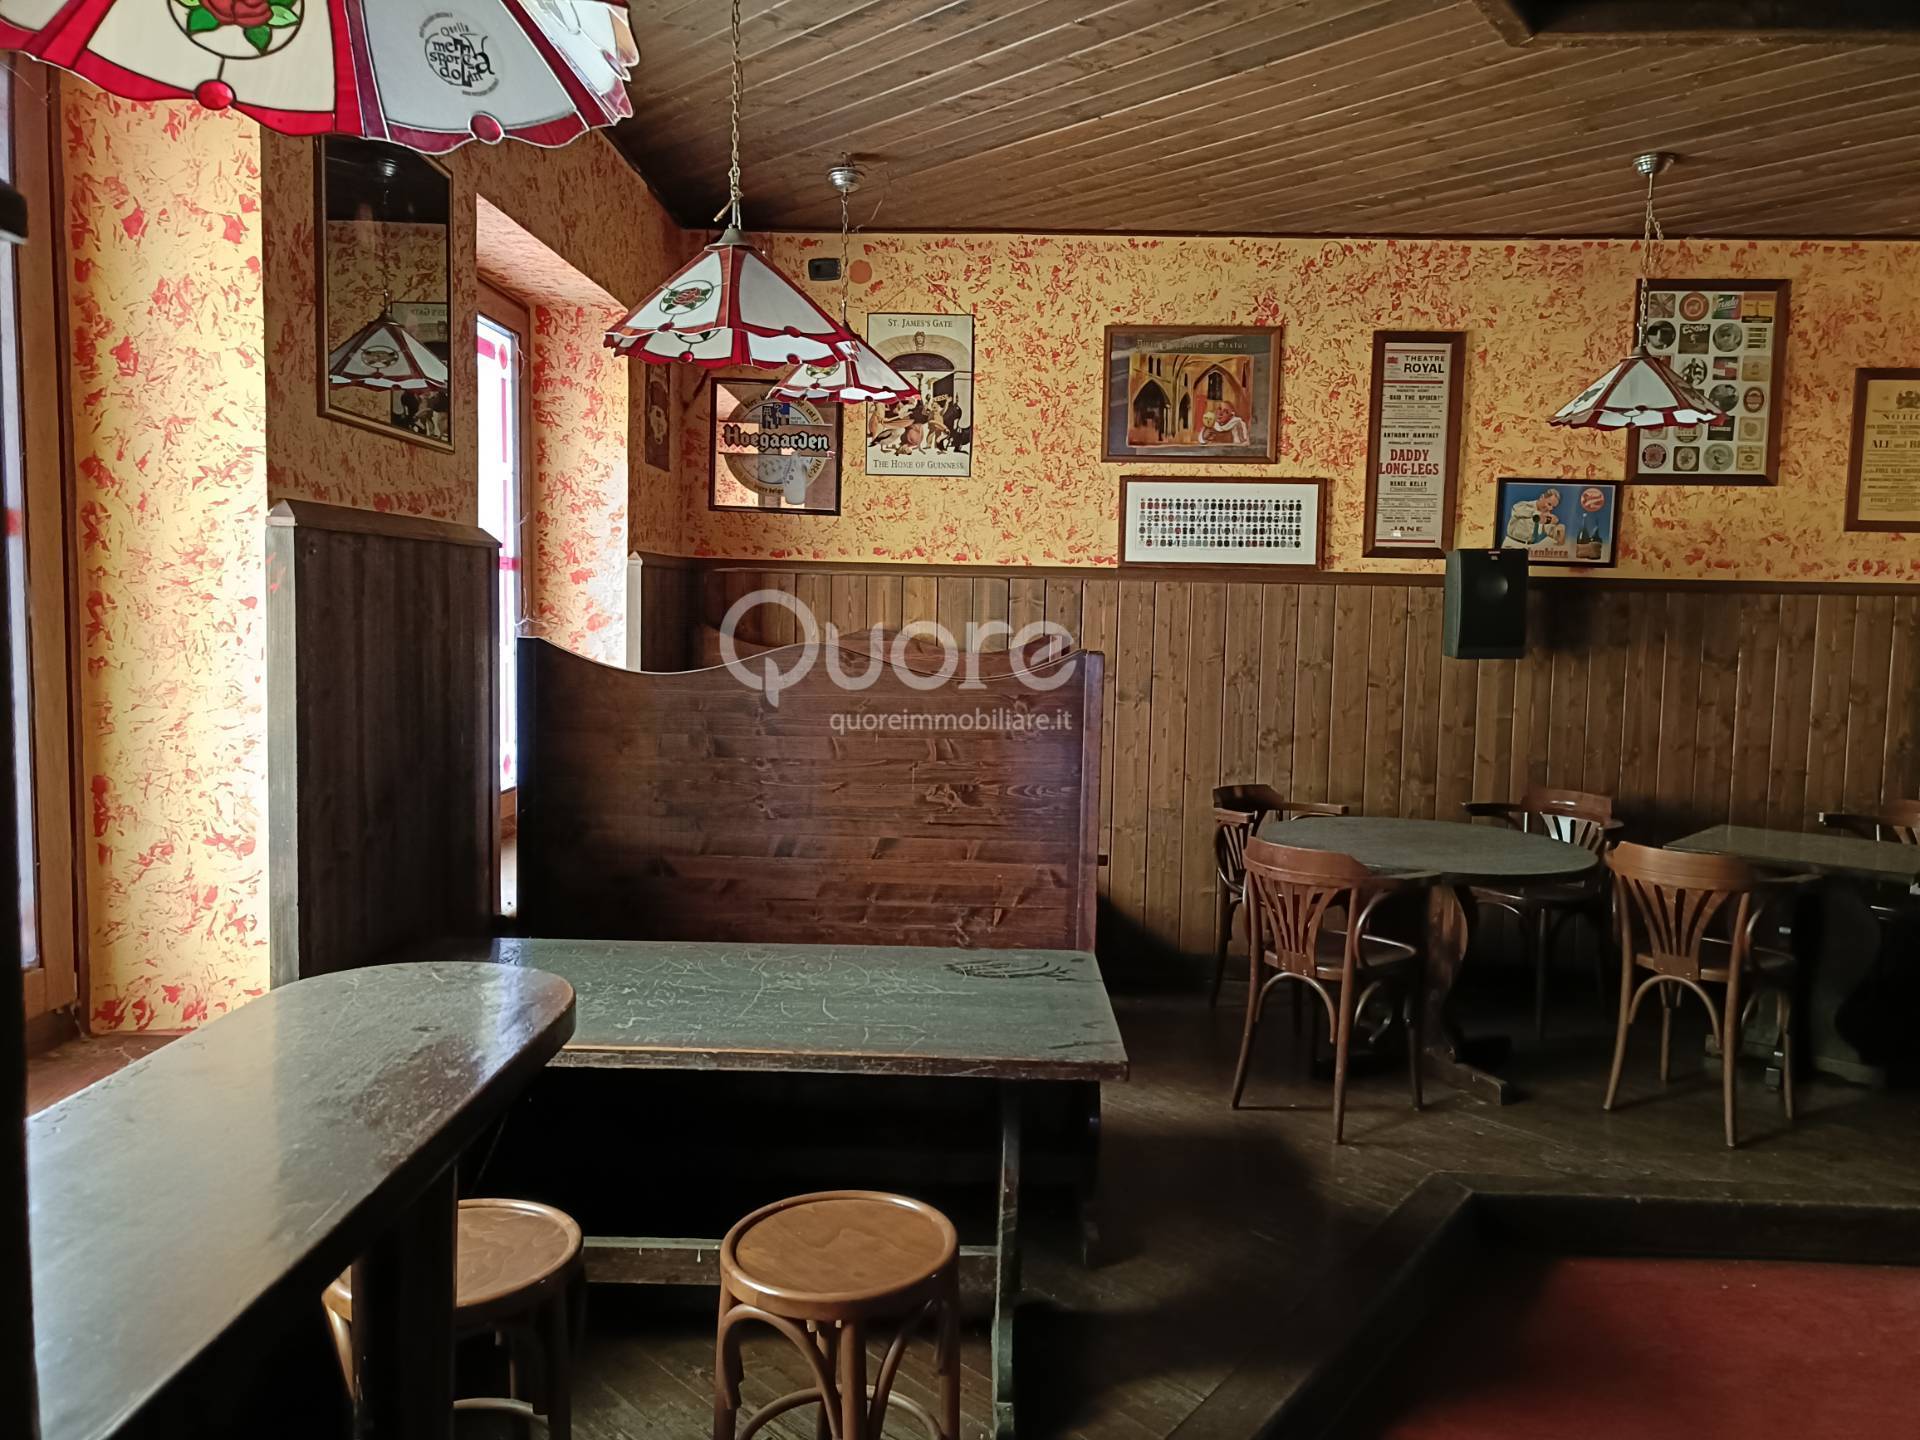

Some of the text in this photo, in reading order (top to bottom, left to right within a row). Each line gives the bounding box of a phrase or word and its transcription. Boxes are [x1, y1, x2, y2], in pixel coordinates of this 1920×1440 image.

[932, 319, 953, 328] GATE
[1403, 363, 1445, 374] ROYAL
[723, 424, 830, 451] Hoegaarden
[1390, 448, 1430, 462] DADDY
[872, 459, 889, 469] THE
[890, 459, 915, 469] HOME
[926, 460, 965, 470] GUINNESS
[1379, 462, 1440, 476] LONG-LEGS
